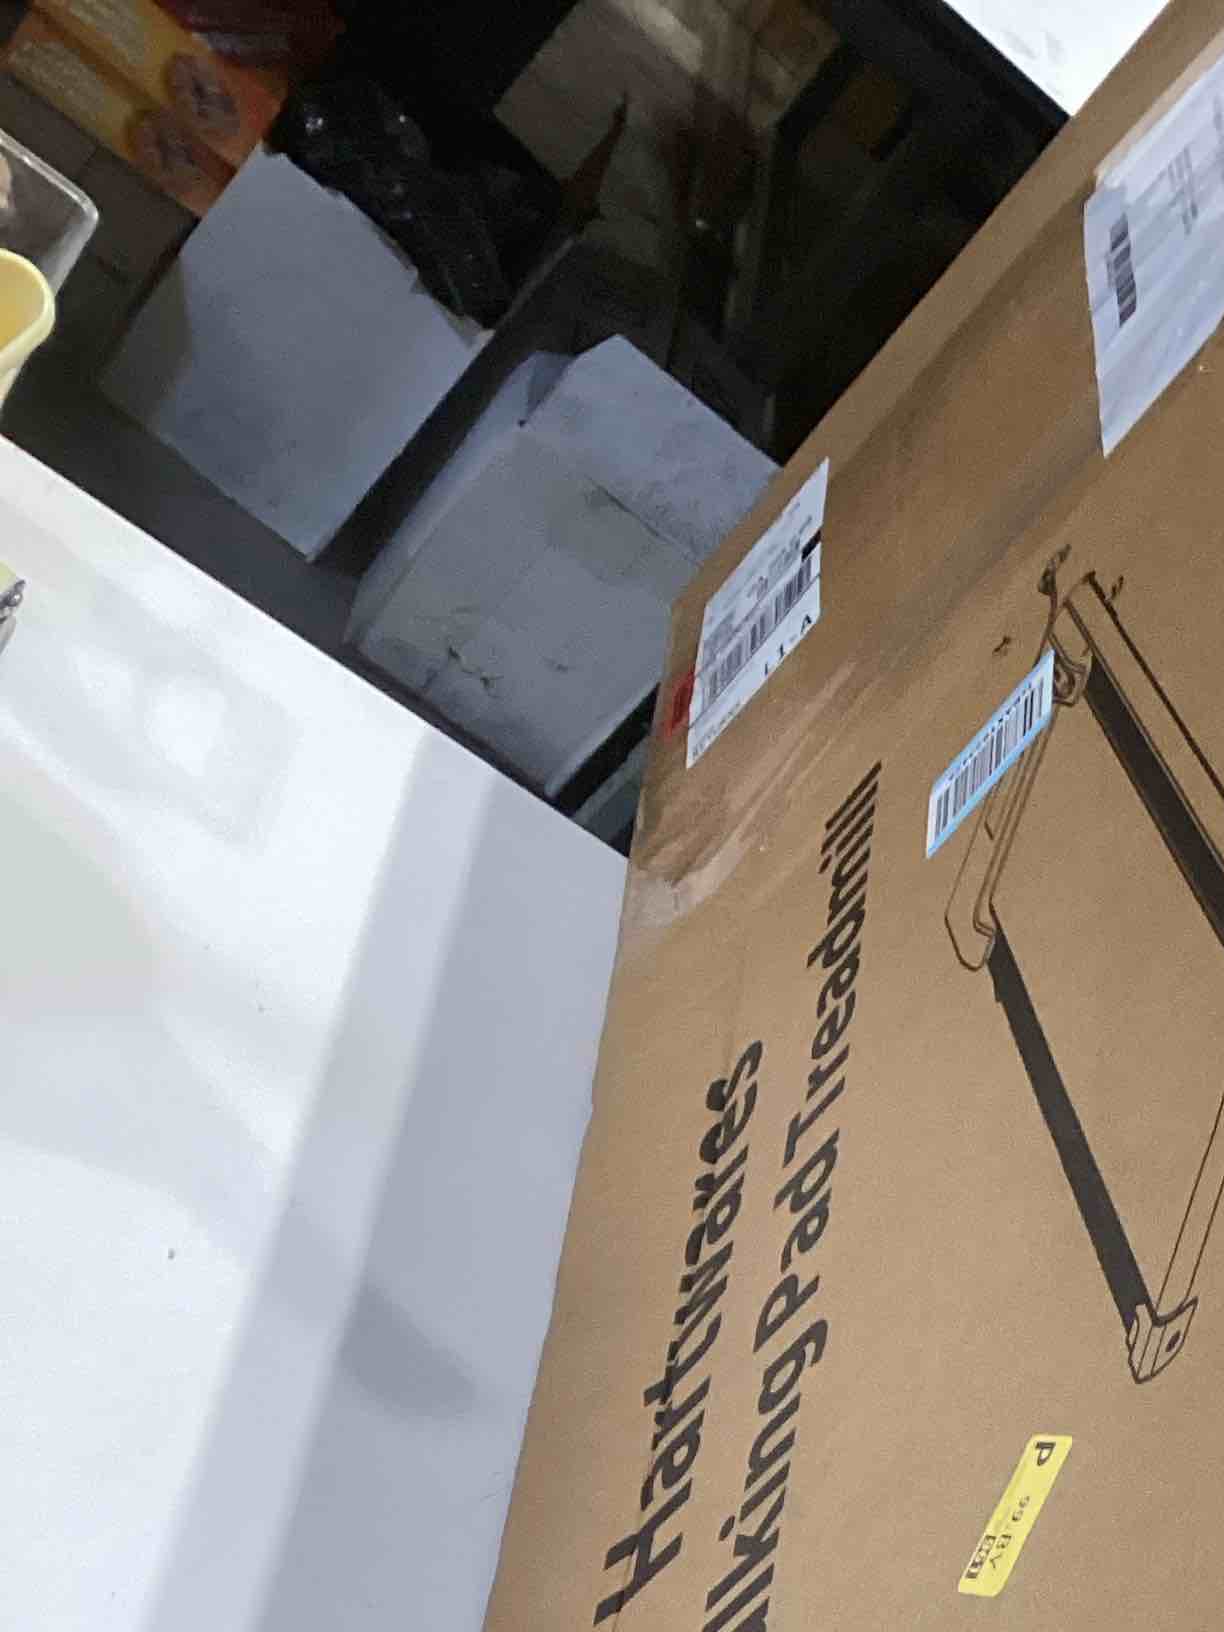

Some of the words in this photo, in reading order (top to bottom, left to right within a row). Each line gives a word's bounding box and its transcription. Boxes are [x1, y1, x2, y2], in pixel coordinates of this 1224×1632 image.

[783, 760, 882, 1168] Treadmill
[594, 1039, 763, 1627] Hartwares
[753, 1127, 840, 1353] Pad
